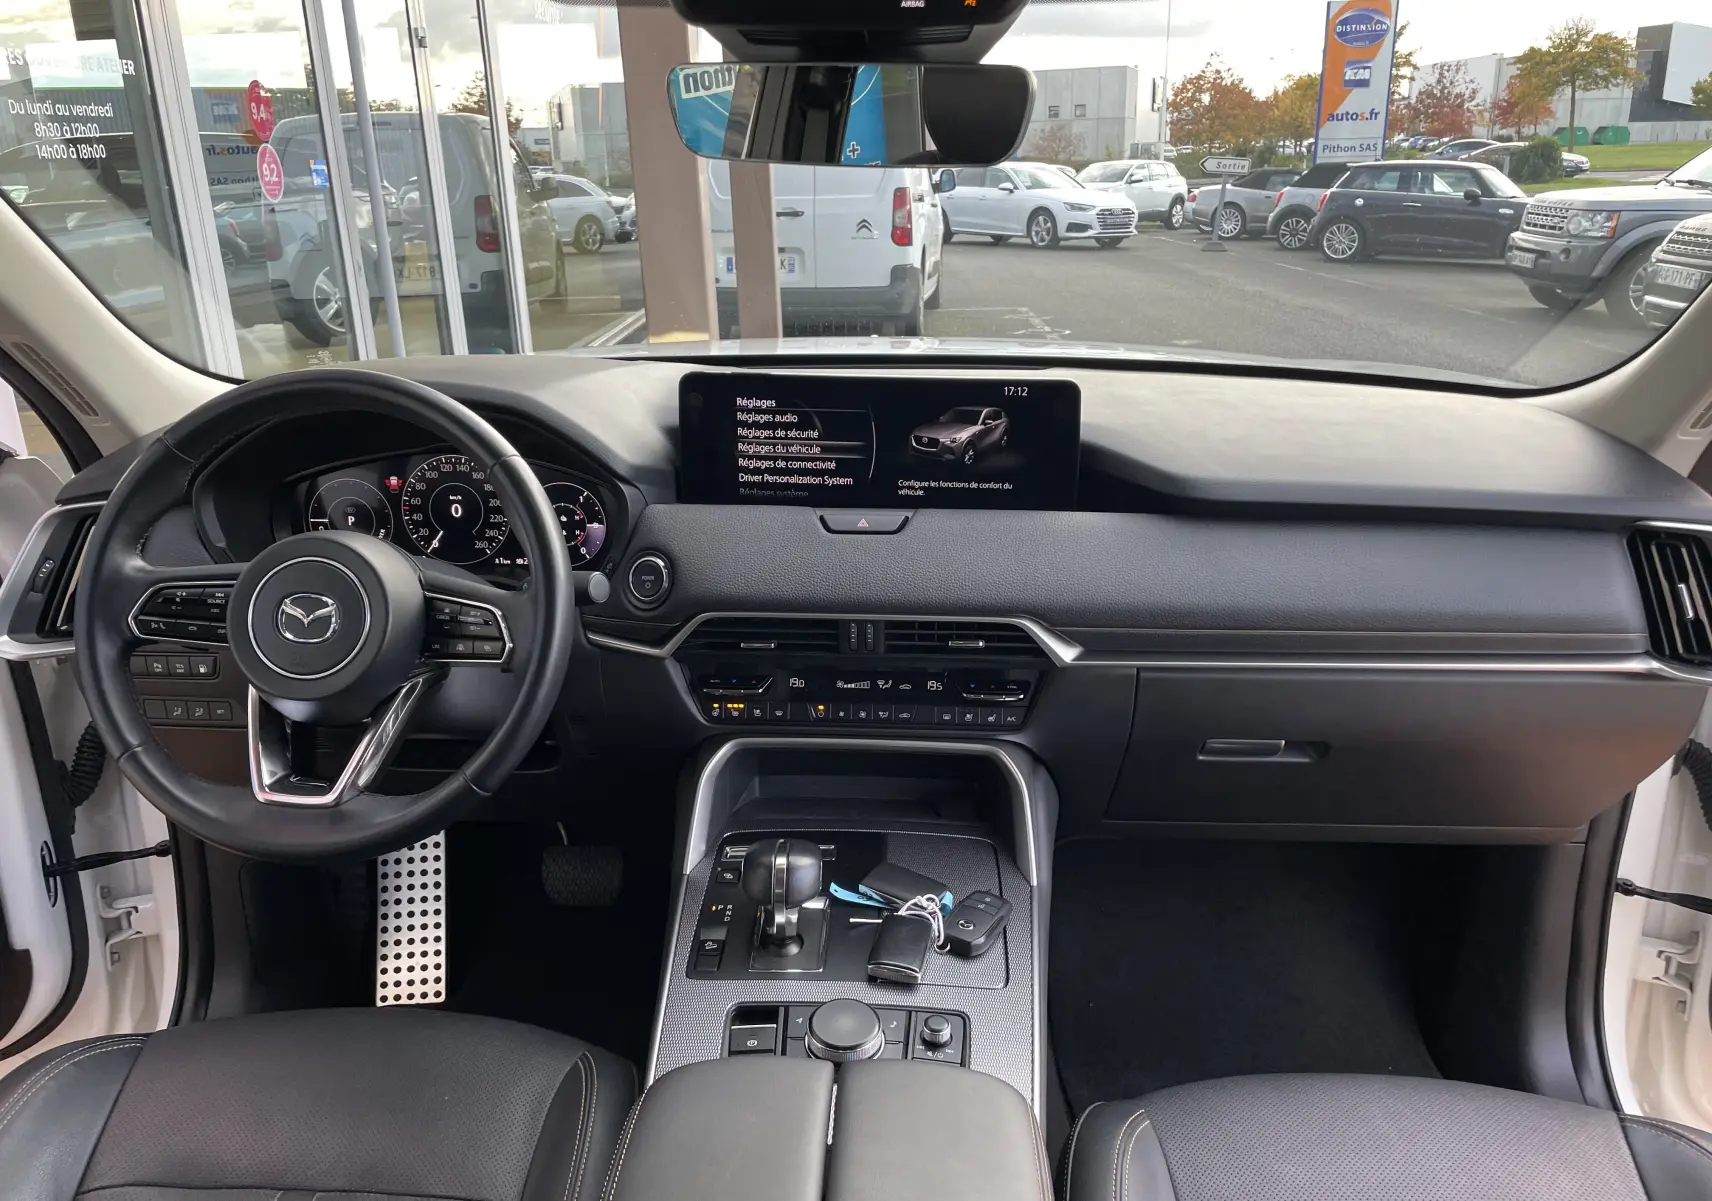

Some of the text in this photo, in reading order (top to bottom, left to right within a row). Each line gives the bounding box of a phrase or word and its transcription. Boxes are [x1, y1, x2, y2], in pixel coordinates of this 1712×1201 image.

[900, 0, 925, 8] AIRBAG
[1336, 23, 1388, 32] DISTINXION
[8, 99, 114, 118] Du lundi au vendredi
[1327, 108, 1381, 122] autos.fr
[34, 122, 100, 138] 8h30 à 12h00
[35, 144, 107, 160] 14h00 à 18h00
[1322, 143, 1378, 153] Pithon SAS
[1215, 161, 1246, 170] Sortie
[1004, 386, 1028, 396] 17:12
[736, 397, 776, 408] Réglages
[737, 411, 798, 423] Réglages audio
[737, 427, 819, 438] Réglages de sécurité
[738, 442, 821, 454] Réglages du véhicule
[456, 464, 469, 472] 140
[738, 458, 836, 470] Réglages de connectivité
[425, 471, 438, 479] 100
[738, 473, 853, 486] Driver Personalization System
[415, 482, 426, 490] 80
[898, 480, 929, 489] Configure
[939, 480, 969, 488] fonctions
[969, 481, 978, 489] de
[1003, 482, 1013, 490] du
[451, 503, 462, 517] 0
[347, 516, 355, 526] P
[418, 528, 429, 536] 20
[485, 529, 498, 537] 240
[474, 540, 488, 548] 260
[580, 546, 586, 554] 0
